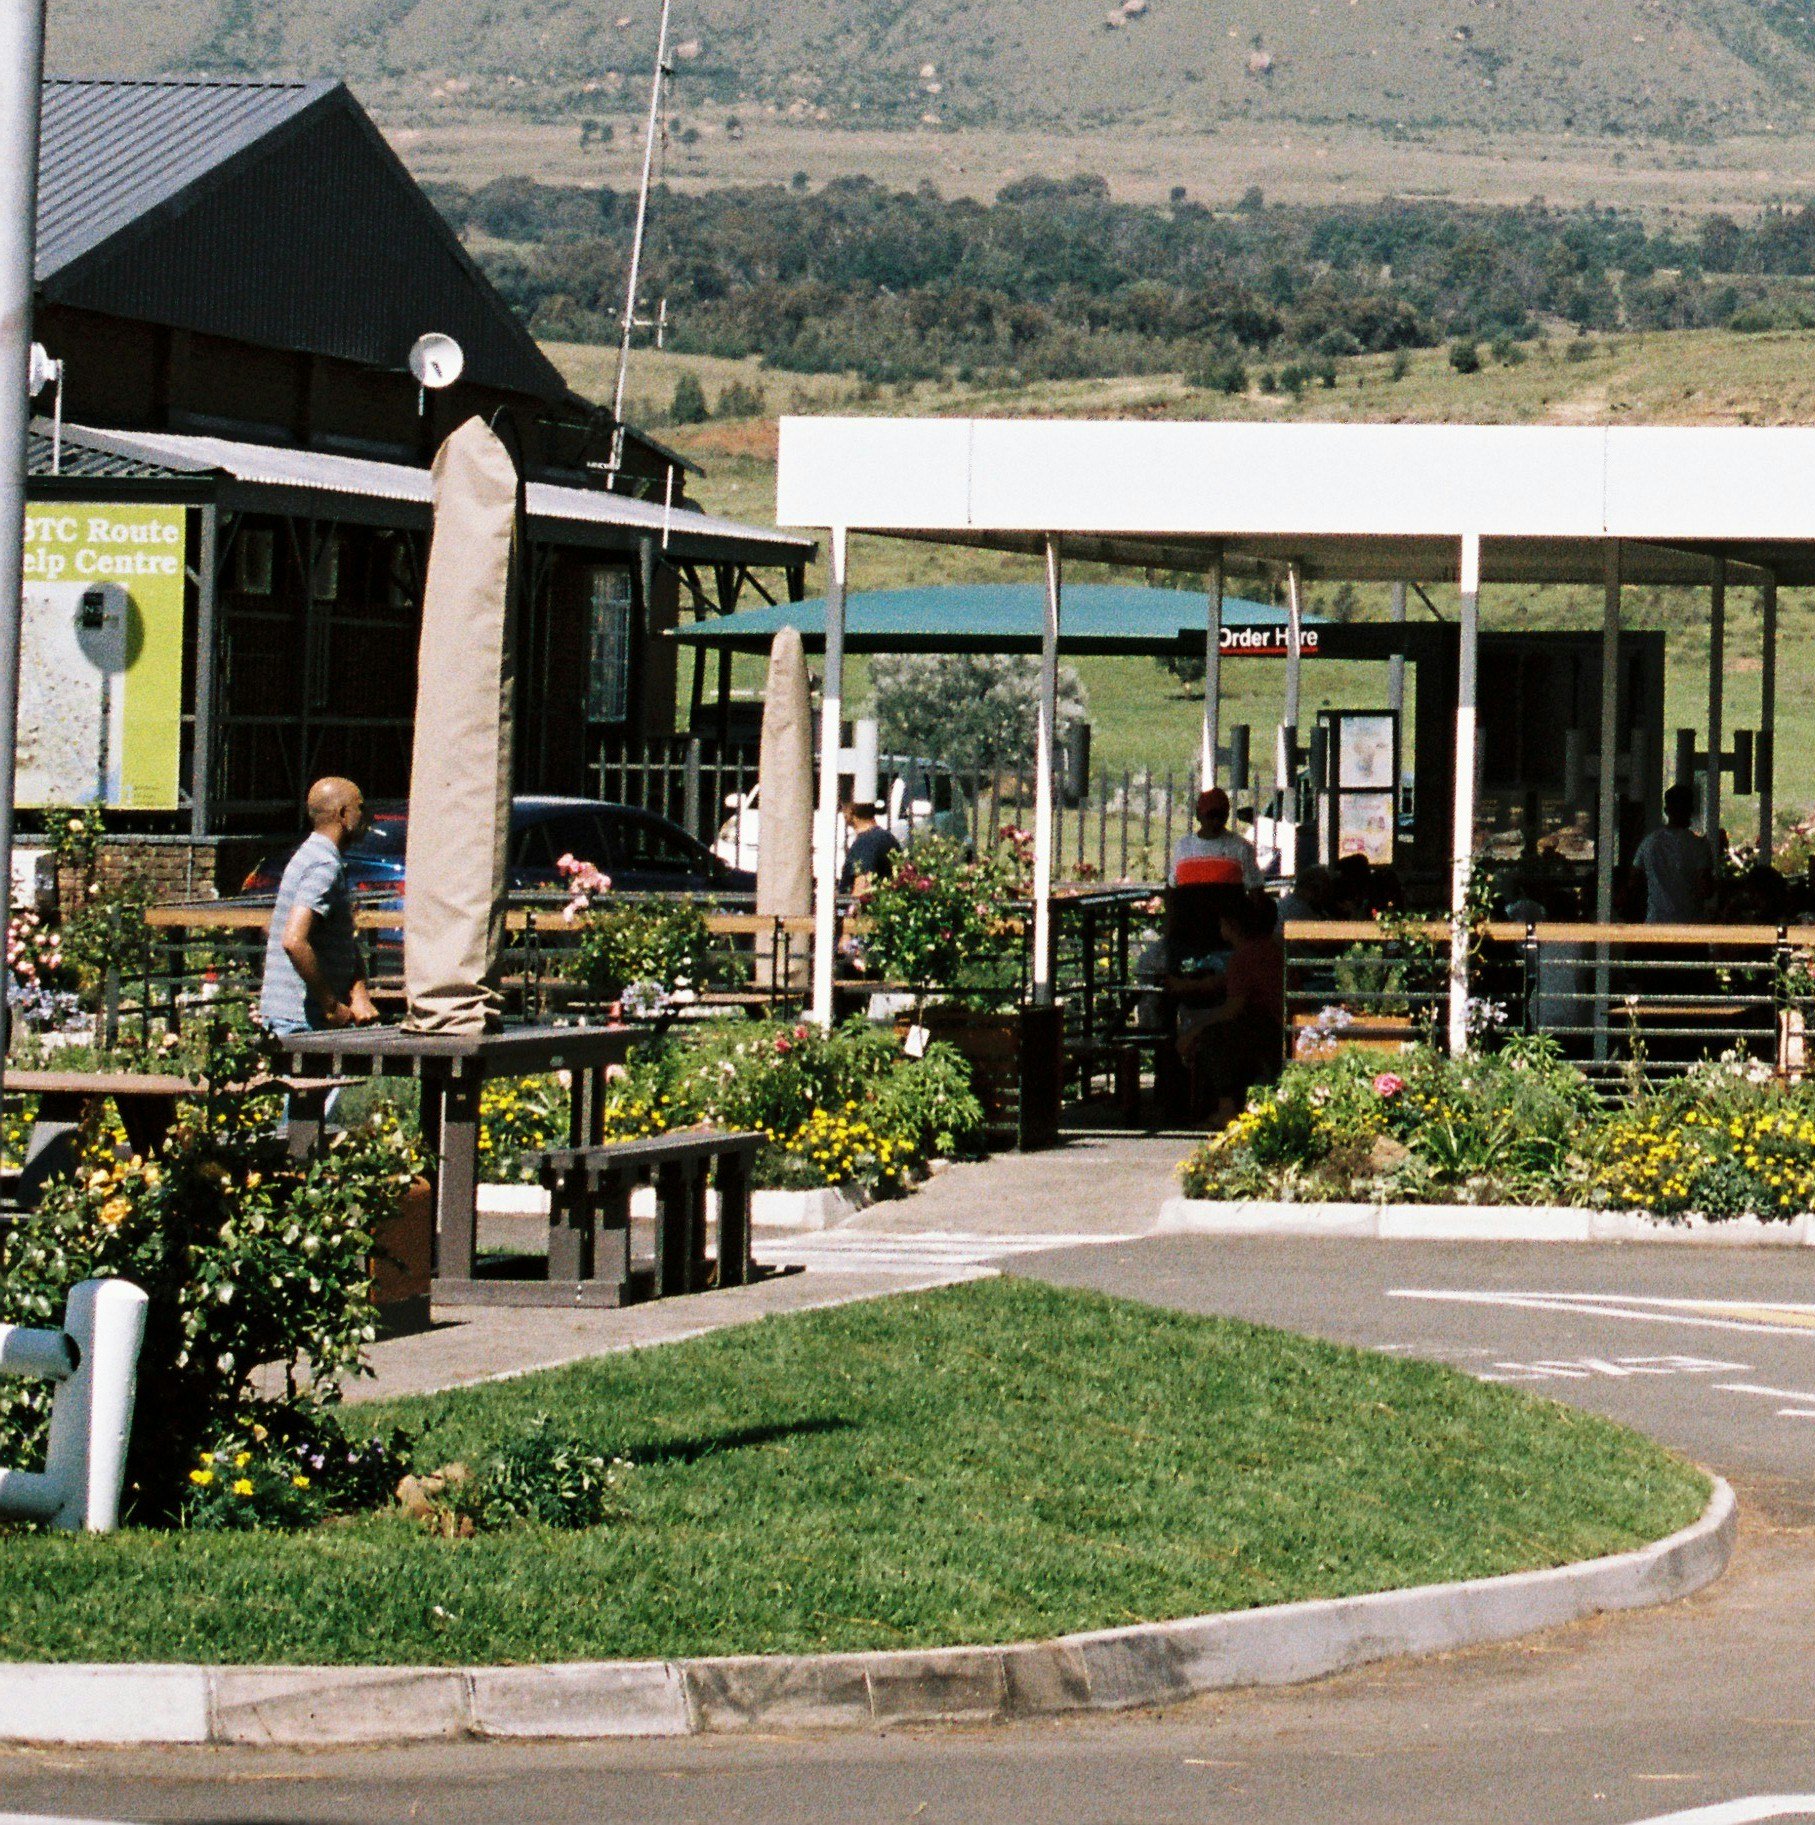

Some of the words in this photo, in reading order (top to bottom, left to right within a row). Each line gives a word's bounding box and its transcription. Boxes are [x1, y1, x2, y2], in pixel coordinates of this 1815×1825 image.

[87, 517, 179, 543] Route
[23, 547, 65, 580] elp
[74, 548, 178, 575] Centre
[1219, 627, 1271, 648] Order
[1275, 627, 1318, 646] Hre
